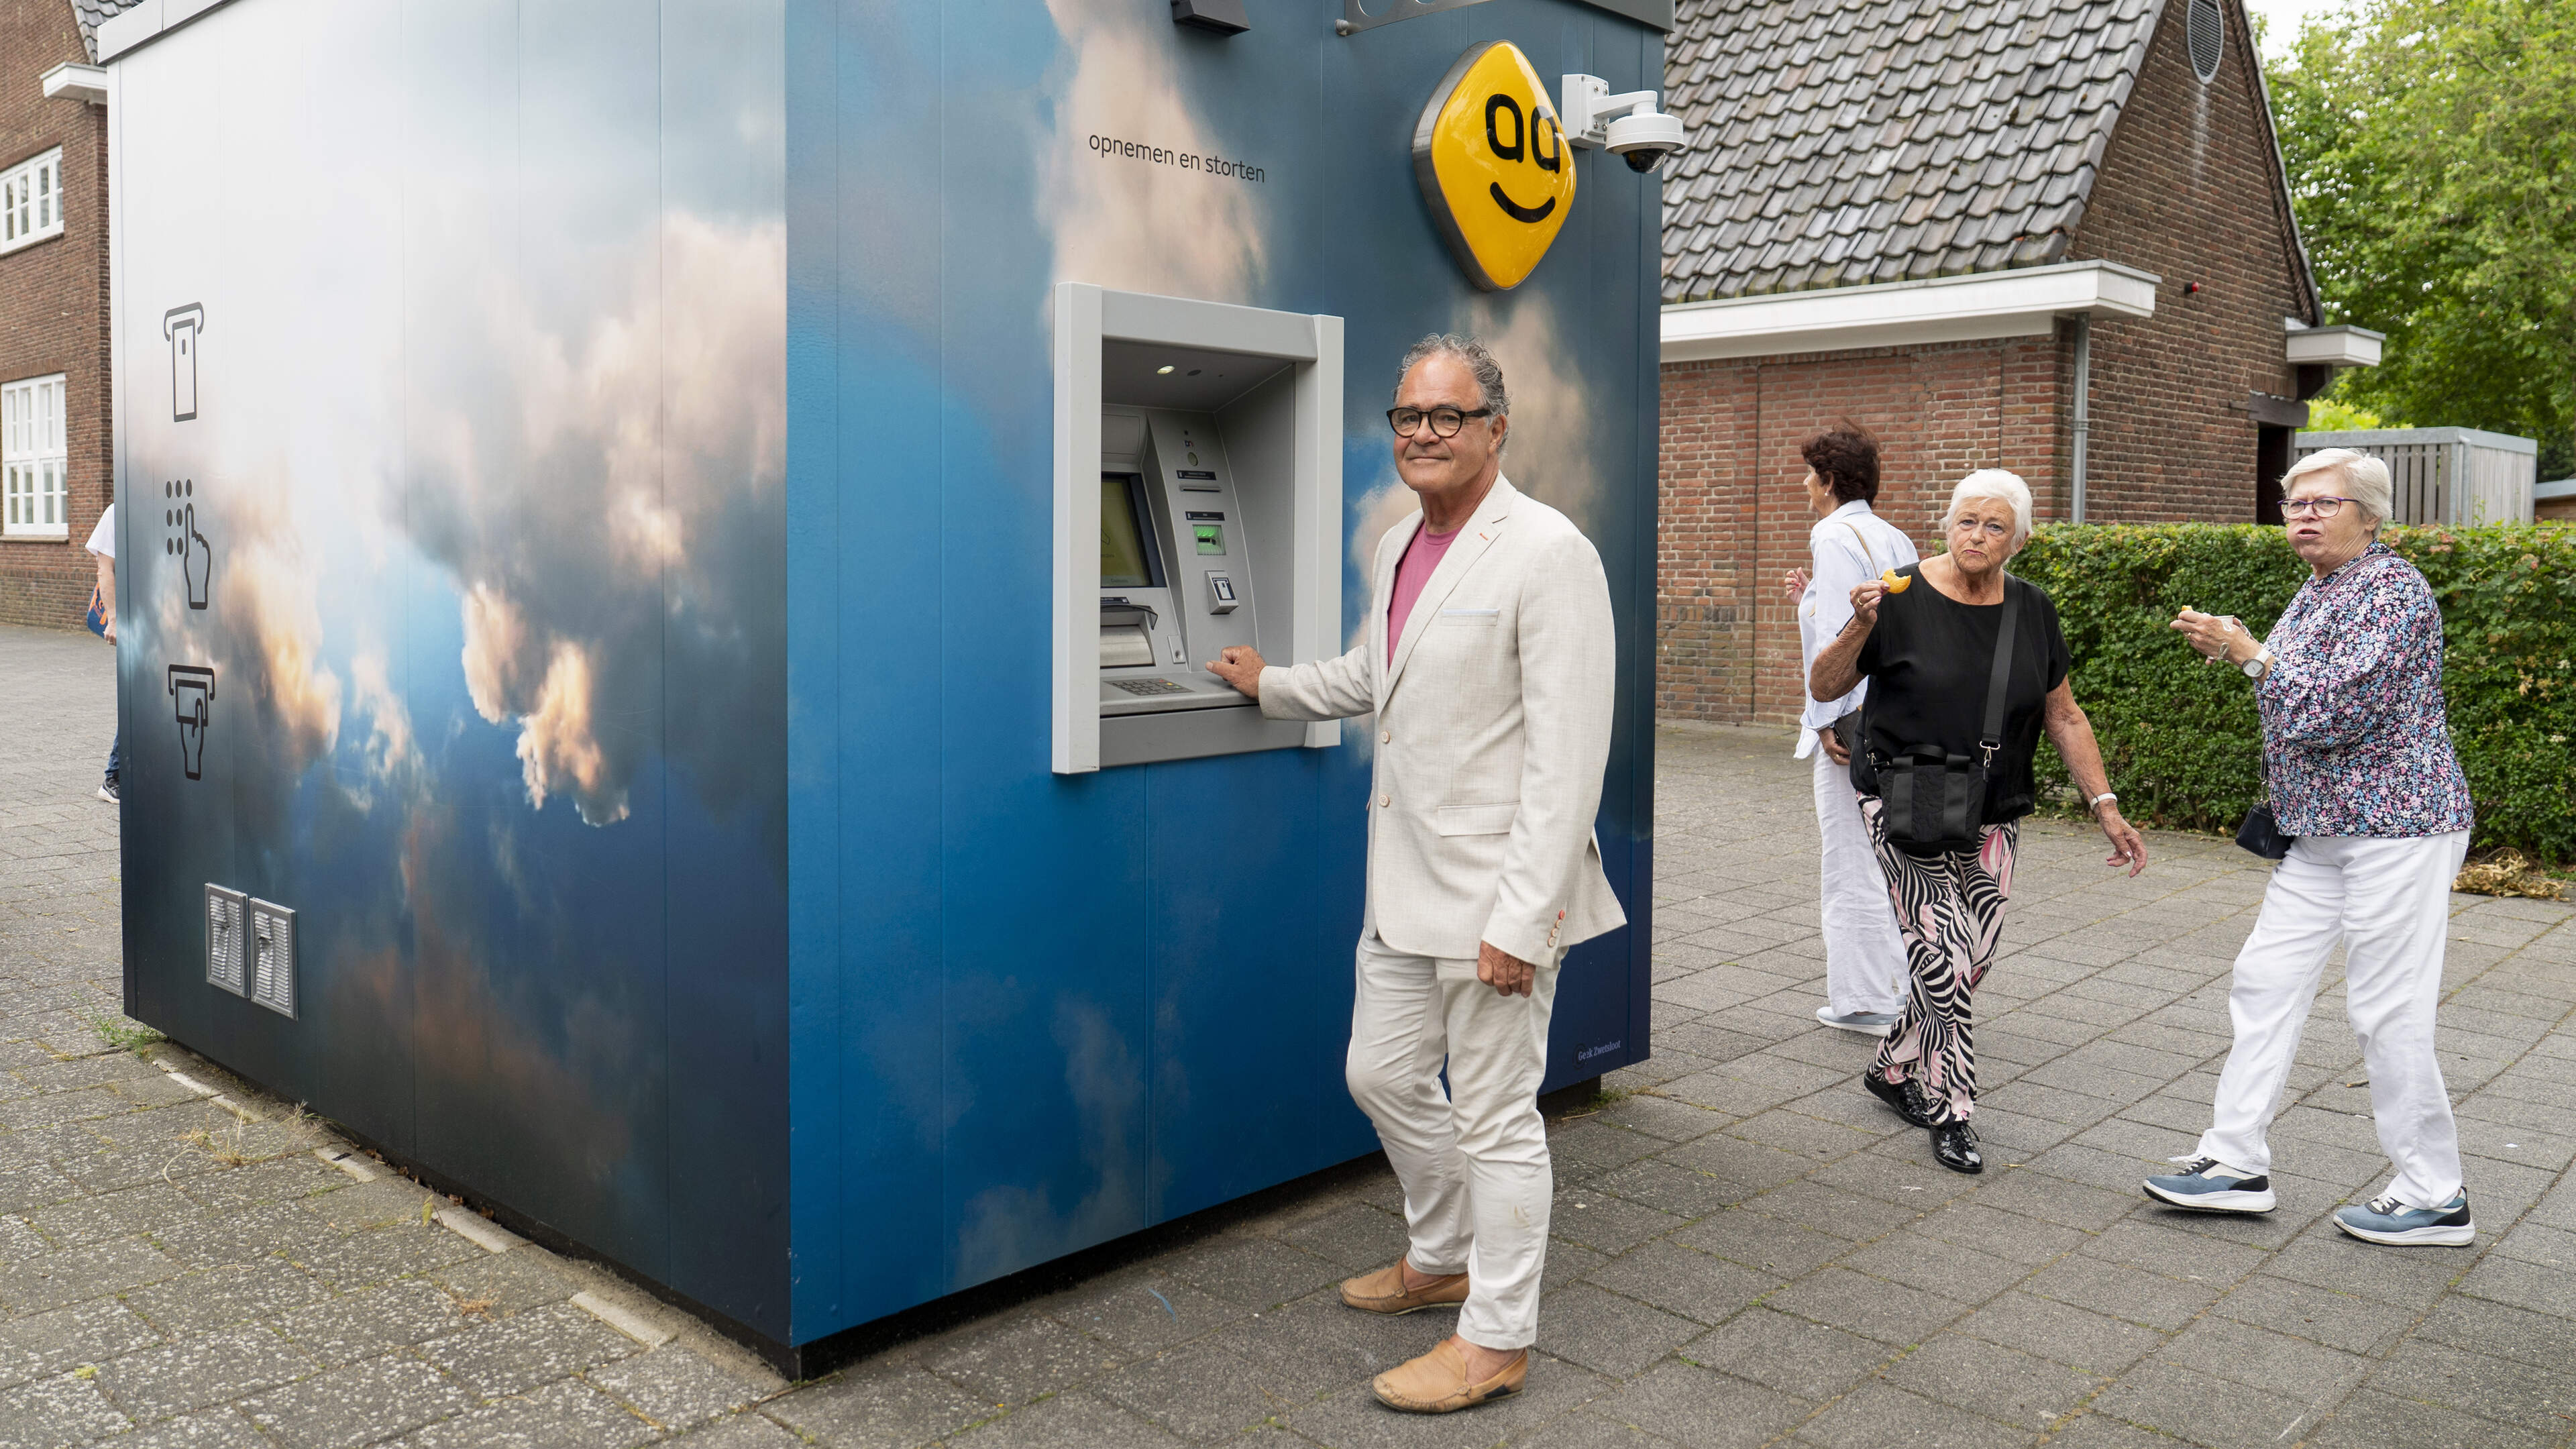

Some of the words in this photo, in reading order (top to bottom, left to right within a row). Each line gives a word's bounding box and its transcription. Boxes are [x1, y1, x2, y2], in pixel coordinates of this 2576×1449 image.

[1089, 134, 1174, 165] opnemen
[1179, 152, 1200, 170] en
[1205, 155, 1265, 183] storten
